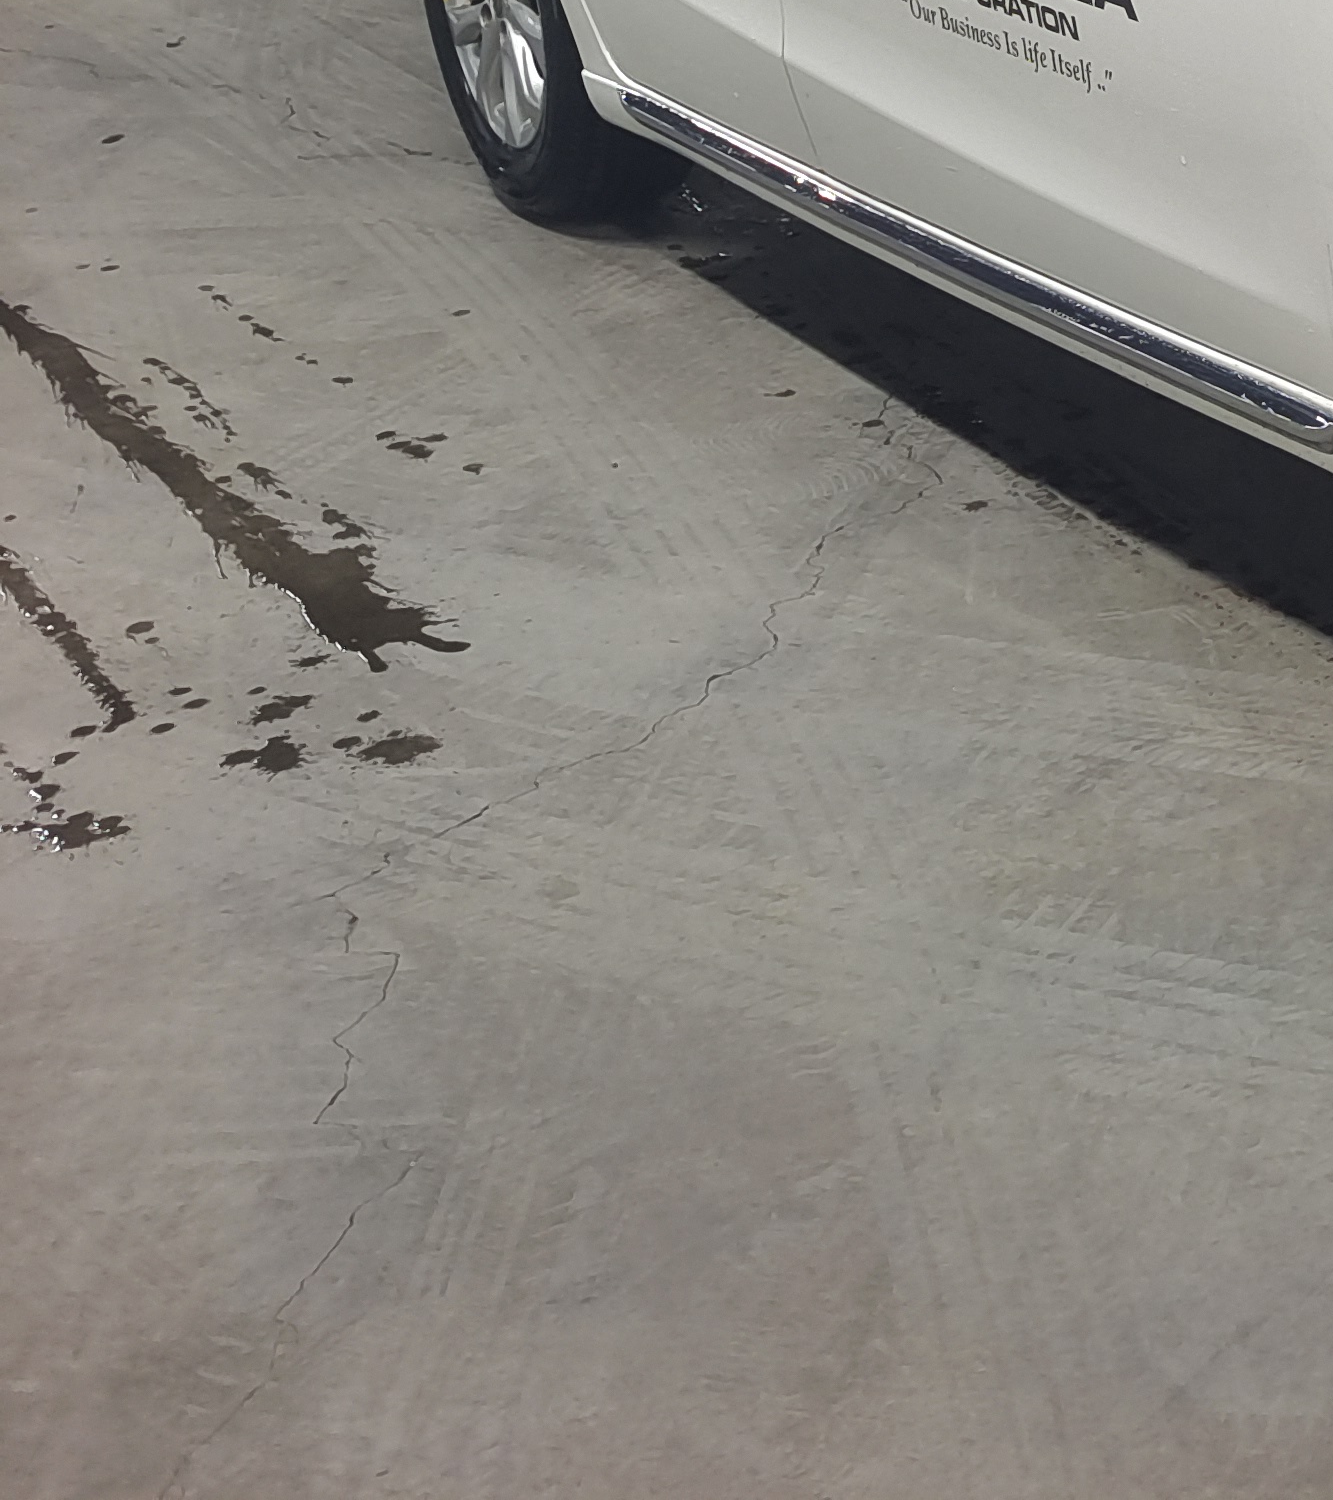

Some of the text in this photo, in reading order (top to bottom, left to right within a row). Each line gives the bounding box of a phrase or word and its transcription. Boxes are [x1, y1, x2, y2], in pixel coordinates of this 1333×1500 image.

[938, 6, 1001, 51] Business
[1003, 30, 1020, 58] Is
[1021, 37, 1047, 73] life
